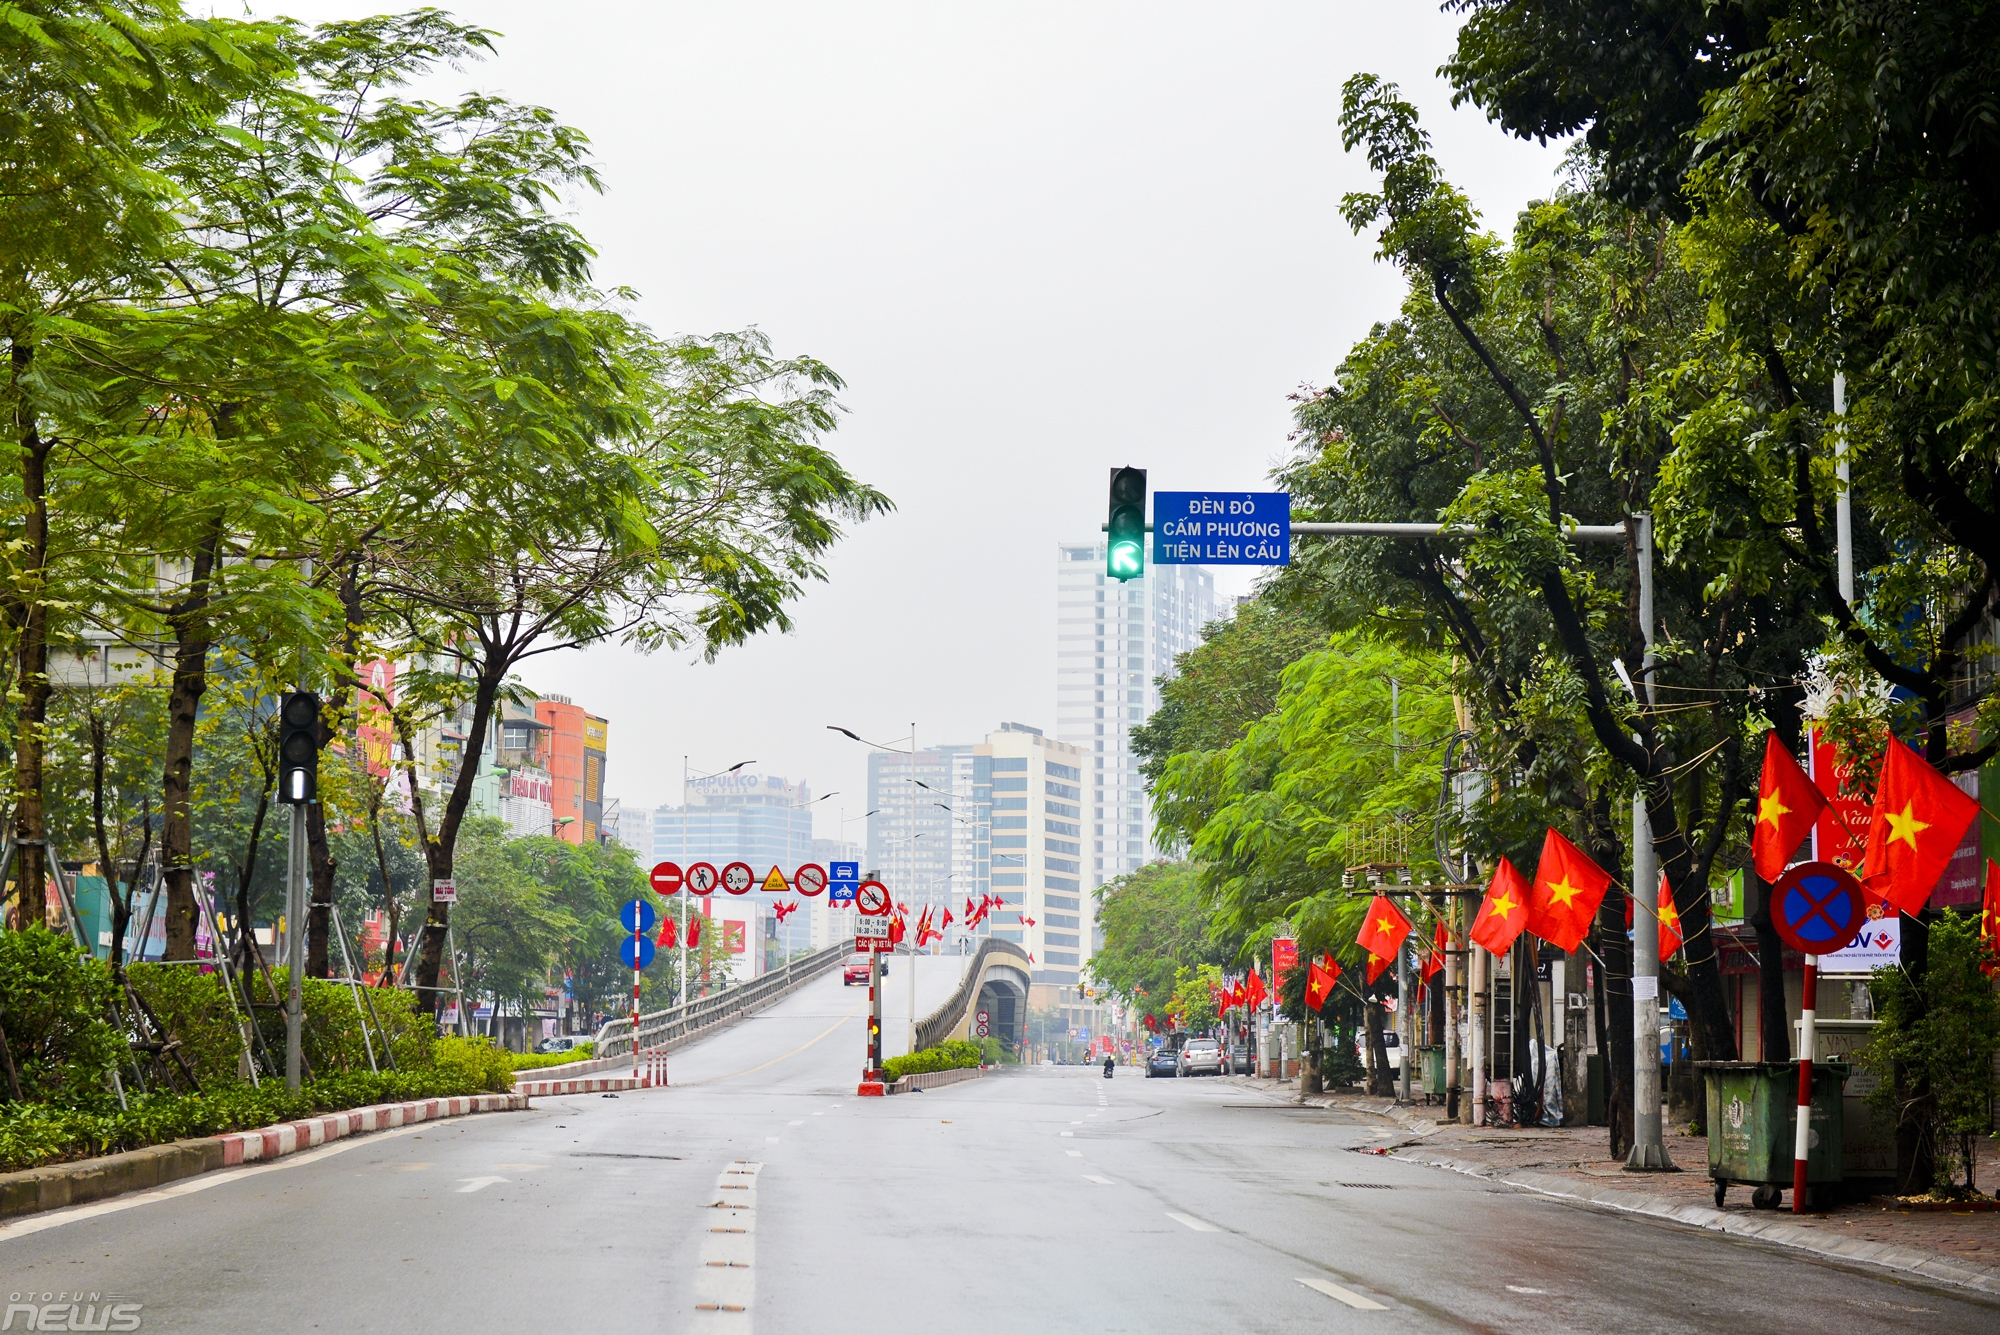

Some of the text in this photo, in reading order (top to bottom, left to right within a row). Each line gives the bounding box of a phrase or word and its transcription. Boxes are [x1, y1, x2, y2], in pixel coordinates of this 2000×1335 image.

[1189, 495, 1256, 515] ĐÈN ĐỎ
[1162, 516, 1281, 537] CẤM PHƯƠNG
[1162, 539, 1281, 562] TIỆN LÊN CẦU
